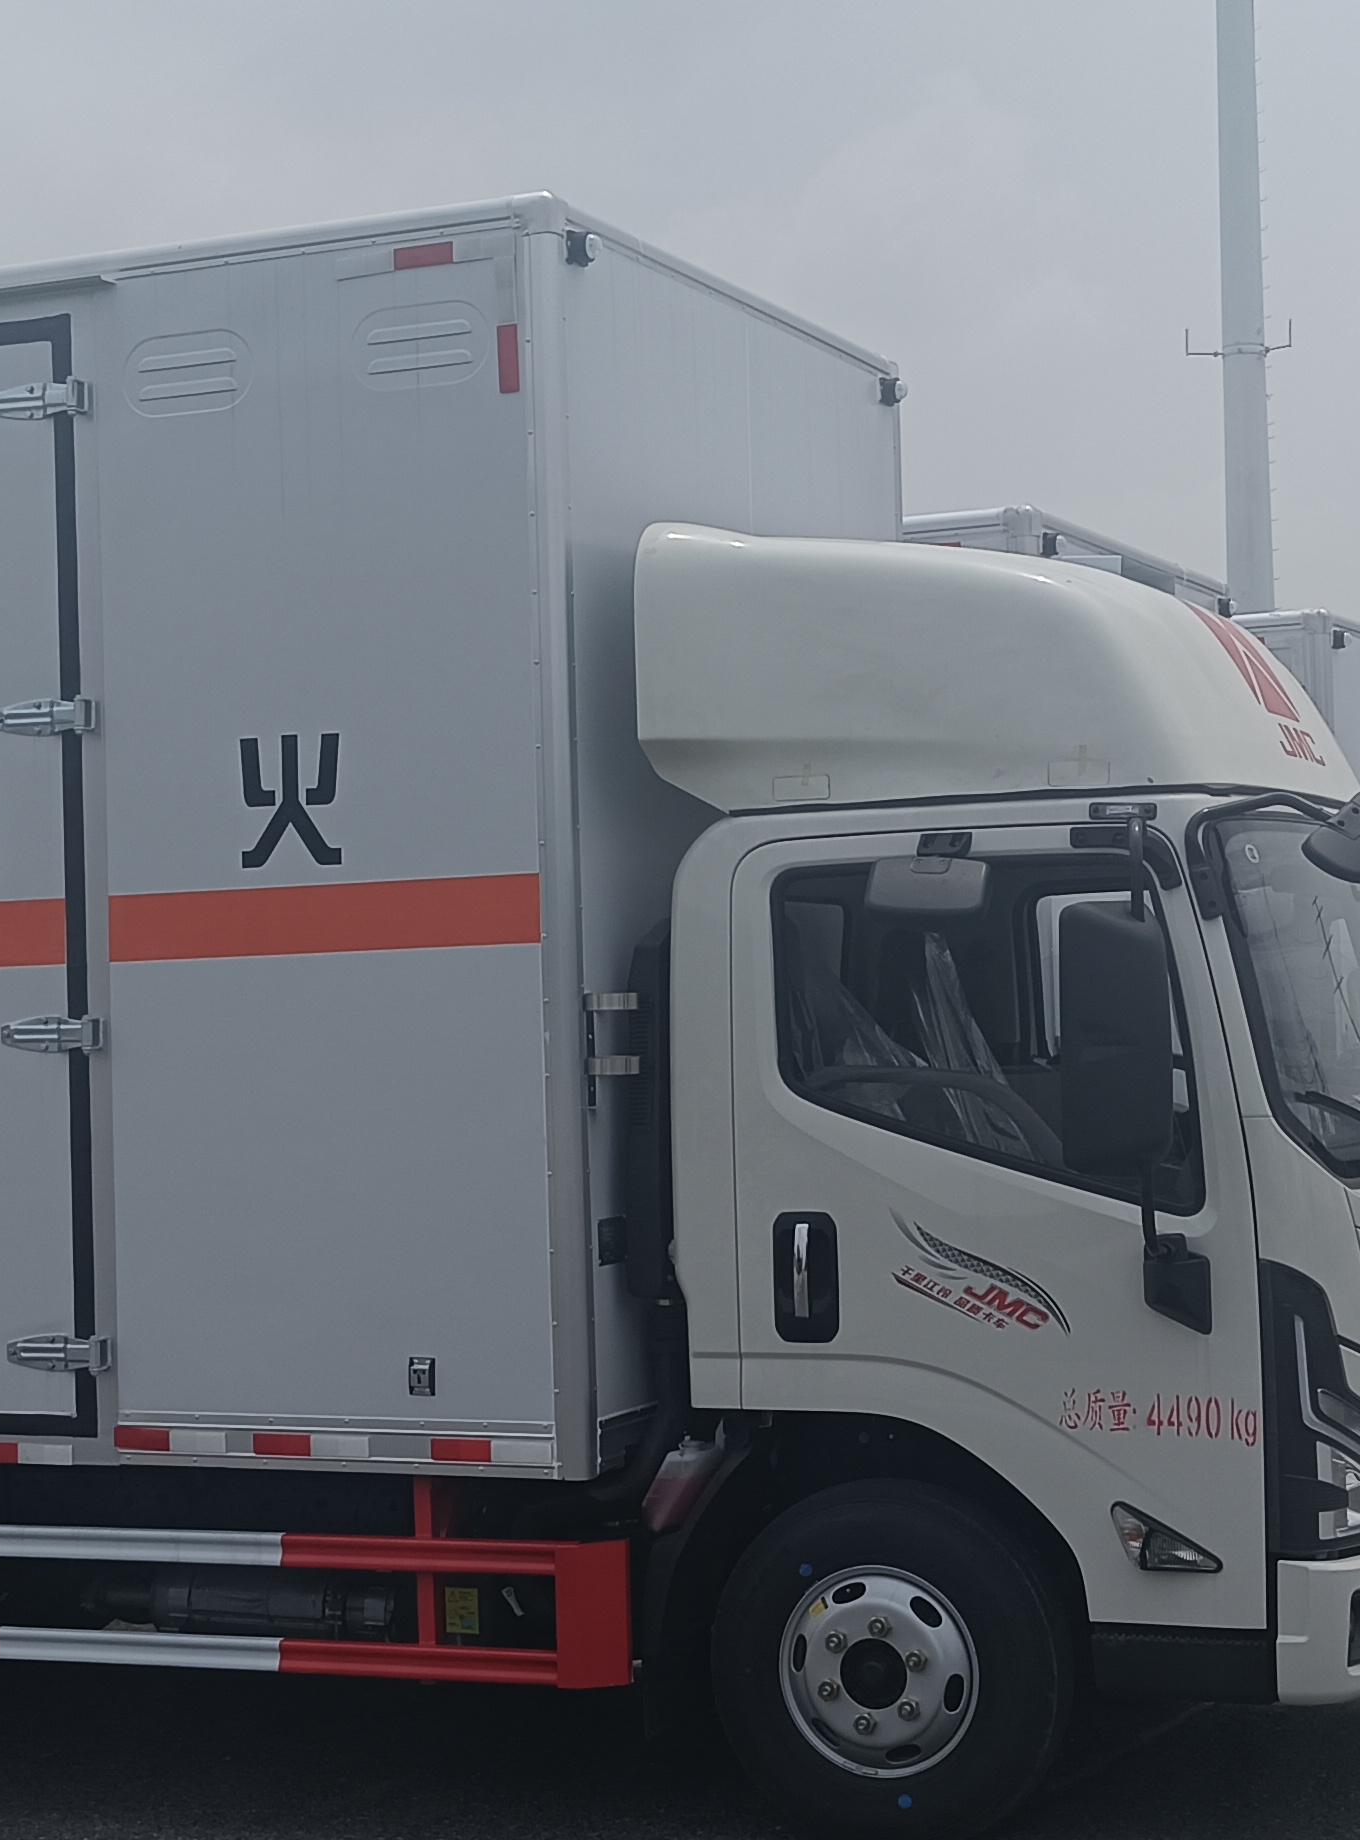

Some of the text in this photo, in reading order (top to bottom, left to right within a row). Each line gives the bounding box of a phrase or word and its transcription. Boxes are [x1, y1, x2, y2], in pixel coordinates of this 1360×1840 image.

[1277, 722, 1326, 767] JMC
[962, 1282, 1051, 1331] JMC
[1145, 1392, 1222, 1440] 4490
[1230, 1397, 1258, 1448] kg
